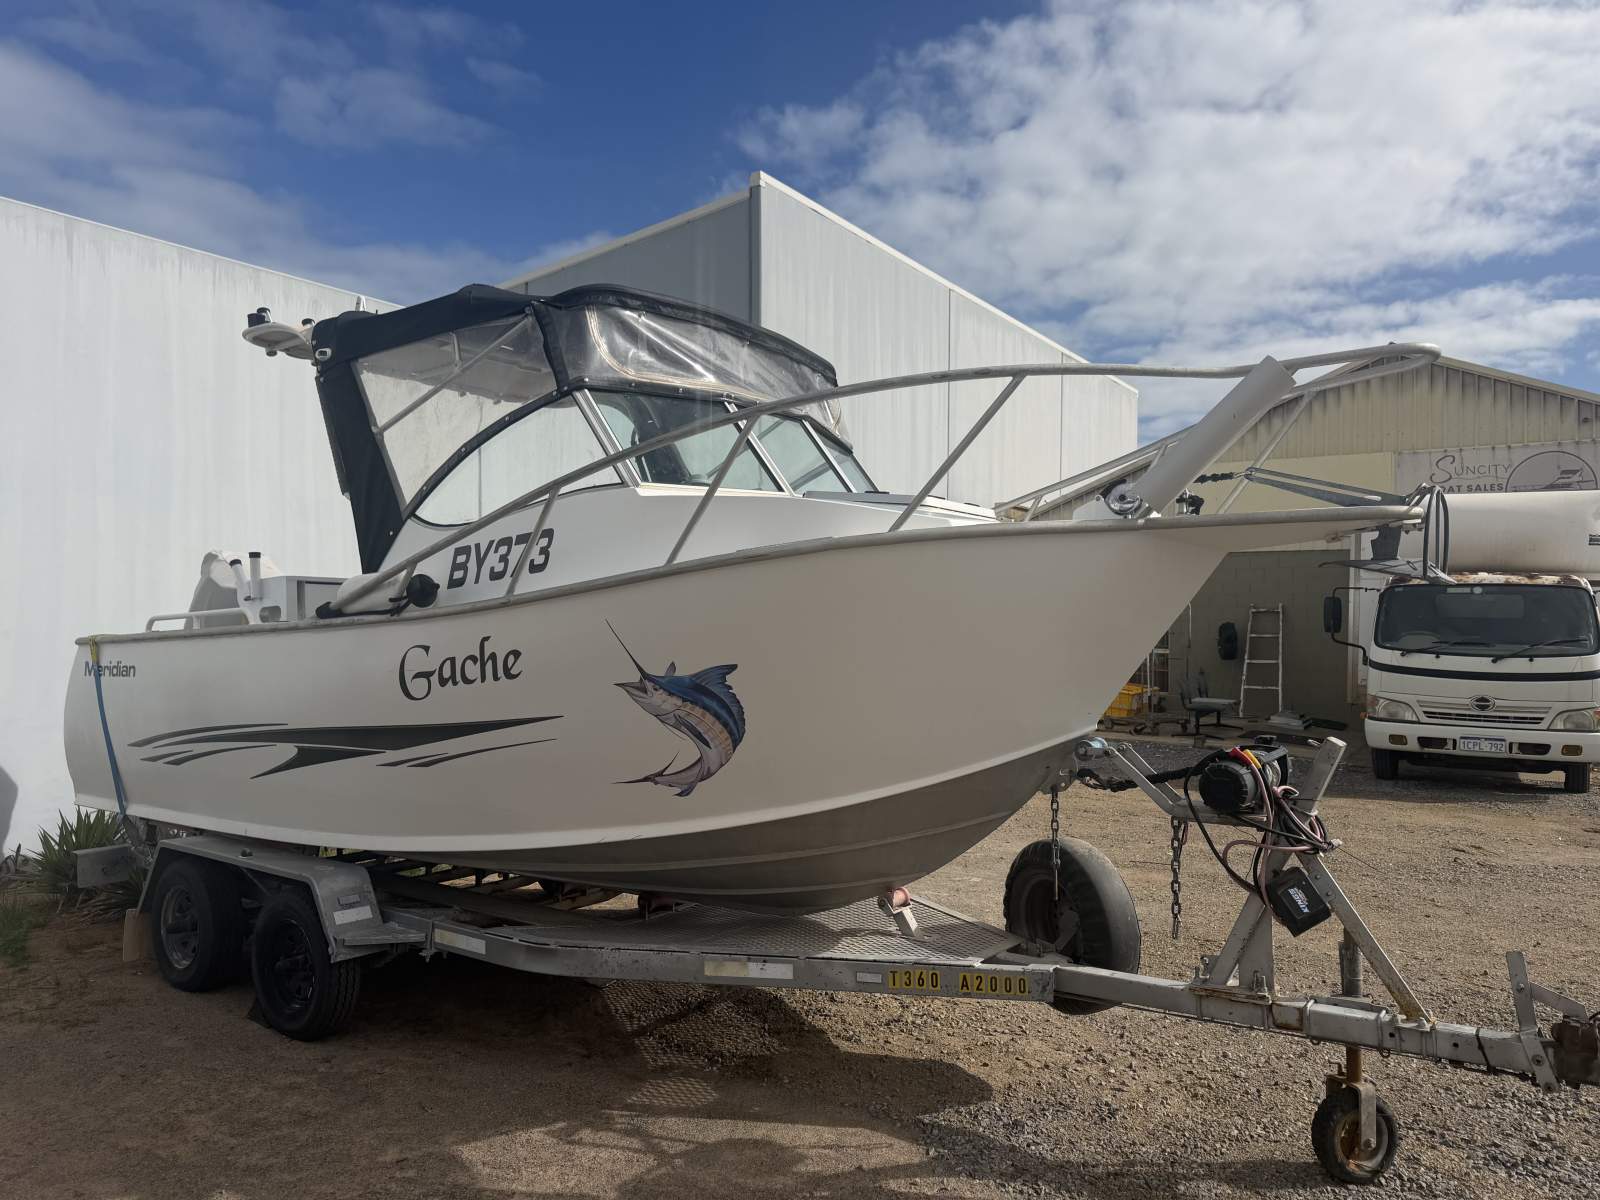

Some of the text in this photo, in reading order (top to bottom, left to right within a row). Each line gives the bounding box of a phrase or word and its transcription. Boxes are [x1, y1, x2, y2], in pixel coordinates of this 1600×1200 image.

[1466, 483, 1504, 492] SALES
[447, 528, 554, 589] BY373
[84, 660, 136, 677] Meridian
[399, 636, 522, 701] Gache
[889, 970, 1027, 994] T360 A2000
